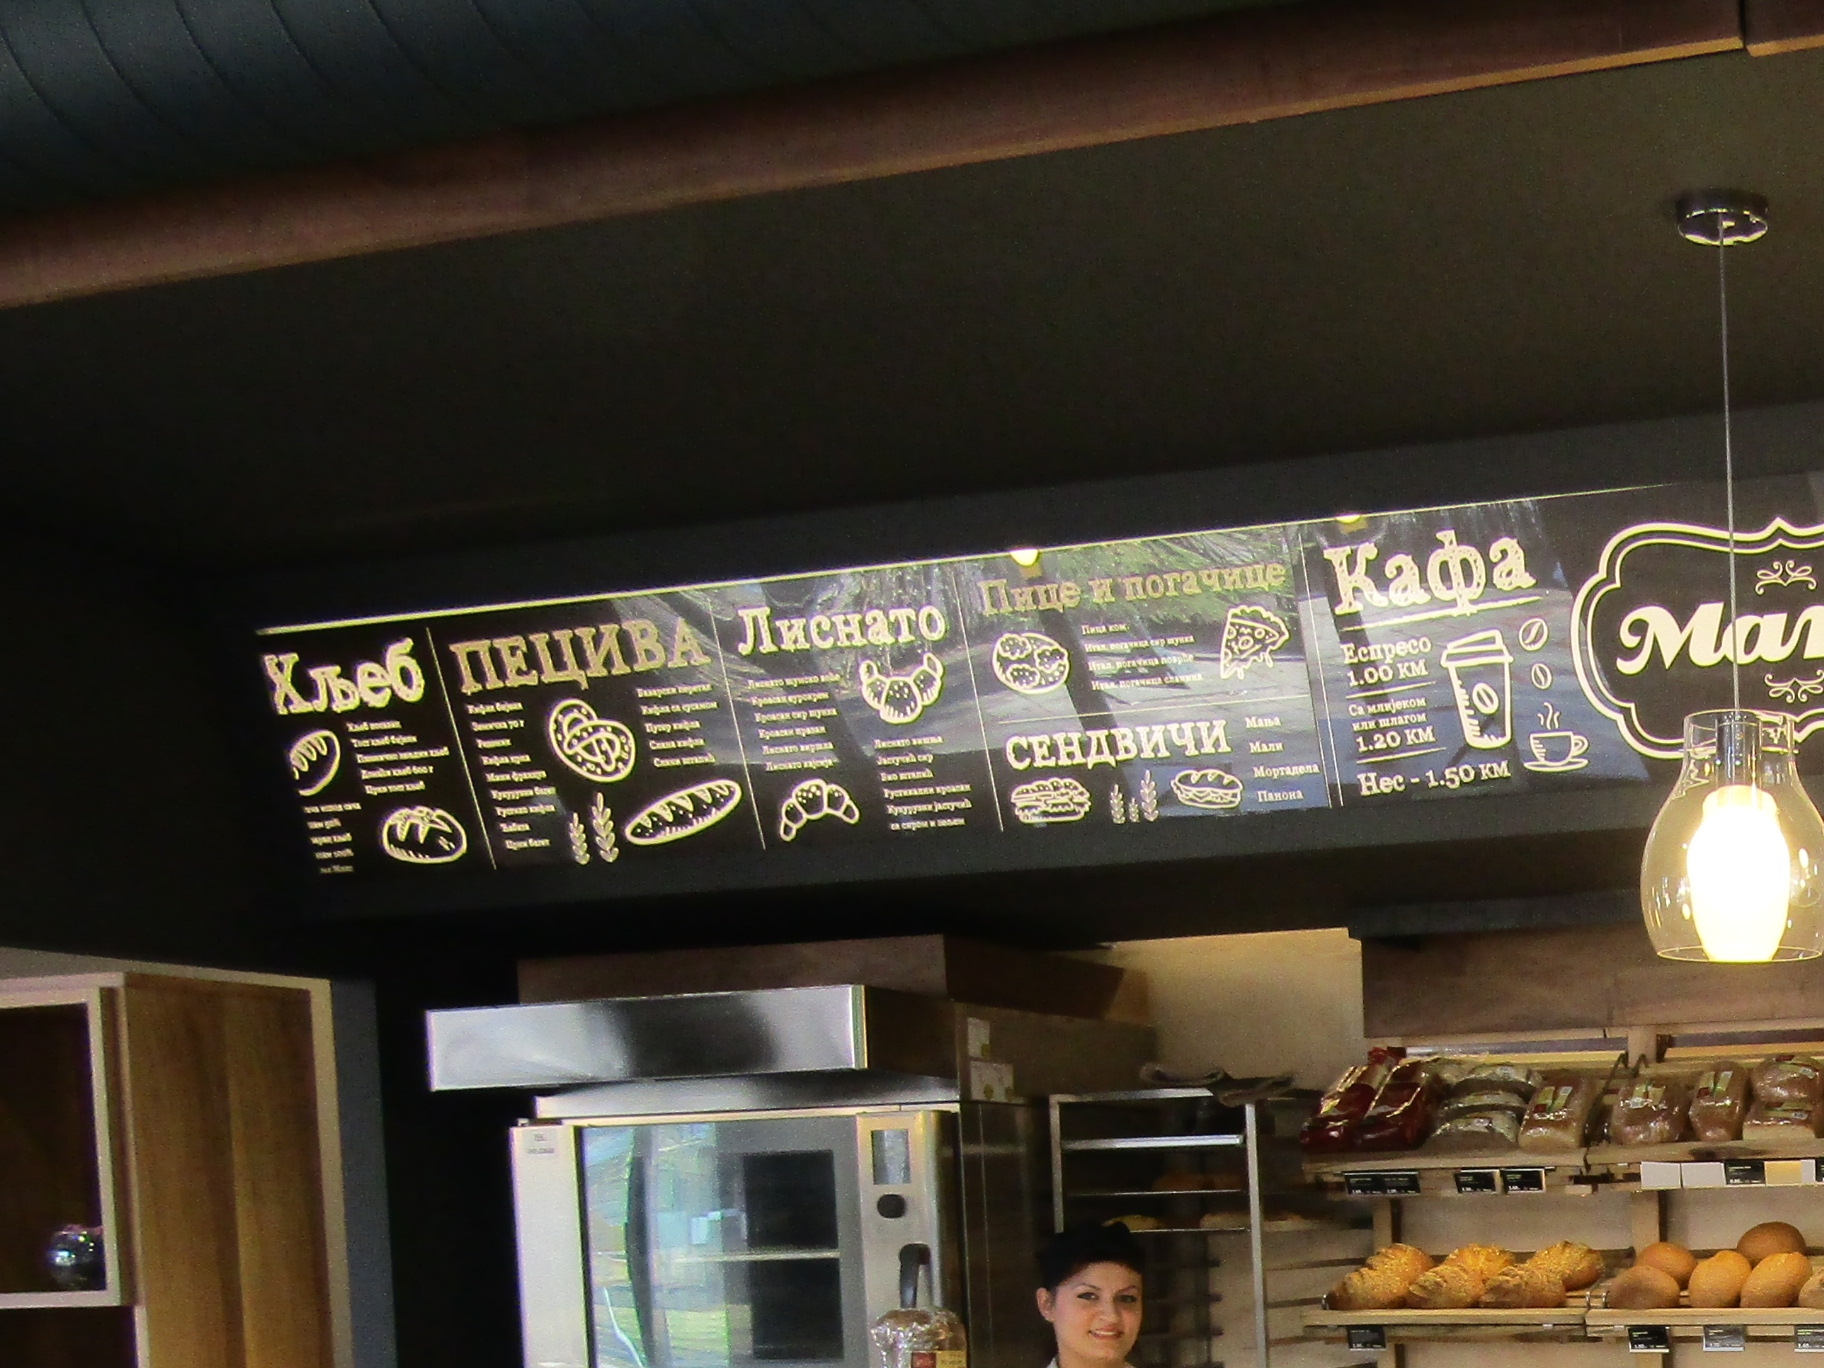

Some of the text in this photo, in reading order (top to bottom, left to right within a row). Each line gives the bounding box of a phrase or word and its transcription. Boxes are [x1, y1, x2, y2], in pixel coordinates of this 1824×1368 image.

[1323, 529, 1537, 617] Кафа
[976, 561, 1287, 615] Пице и погачице
[737, 605, 946, 655] Лиснато
[448, 619, 711, 694] ПЕЦИВА
[1341, 637, 1432, 665] Еспресо
[264, 637, 425, 715] Хљеб
[1349, 660, 1428, 687] 1.00 КМ
[1349, 697, 1426, 717] Са млијеком
[1245, 715, 1281, 730] Мања
[1352, 712, 1426, 731] или шлагом
[1006, 719, 1232, 771] СЕНДВИЧИ
[1250, 740, 1284, 754] Мали
[1356, 726, 1436, 752] 1.20 КМ
[1253, 762, 1320, 778] Мортадела
[1358, 771, 1405, 796] Нес
[1426, 765, 1475, 789] 1.50
[1479, 761, 1511, 780] КМ
[1257, 788, 1304, 803] Панона
